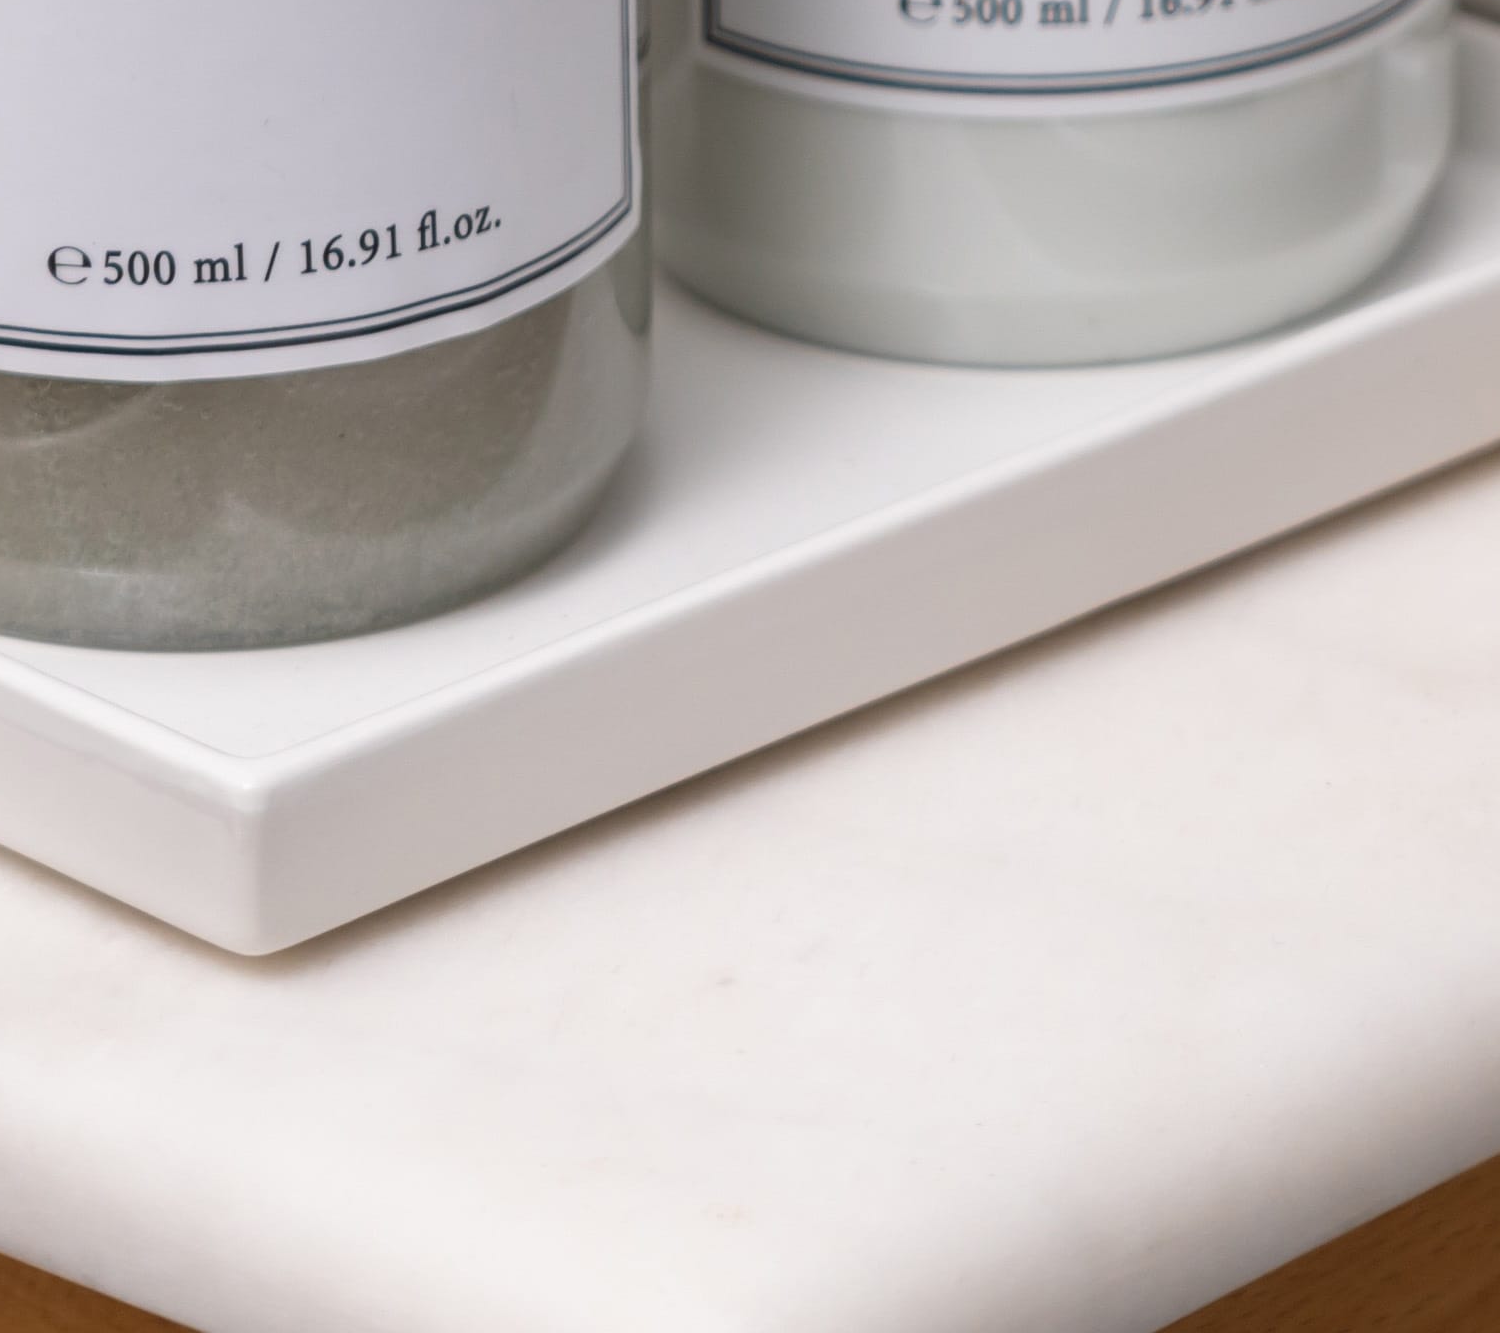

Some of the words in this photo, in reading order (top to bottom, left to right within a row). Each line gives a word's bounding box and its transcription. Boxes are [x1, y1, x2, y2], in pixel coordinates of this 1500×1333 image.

[192, 241, 249, 285] ml
[263, 240, 282, 283] /
[299, 223, 403, 276] 16.91
[416, 204, 503, 253] fl.oz.
